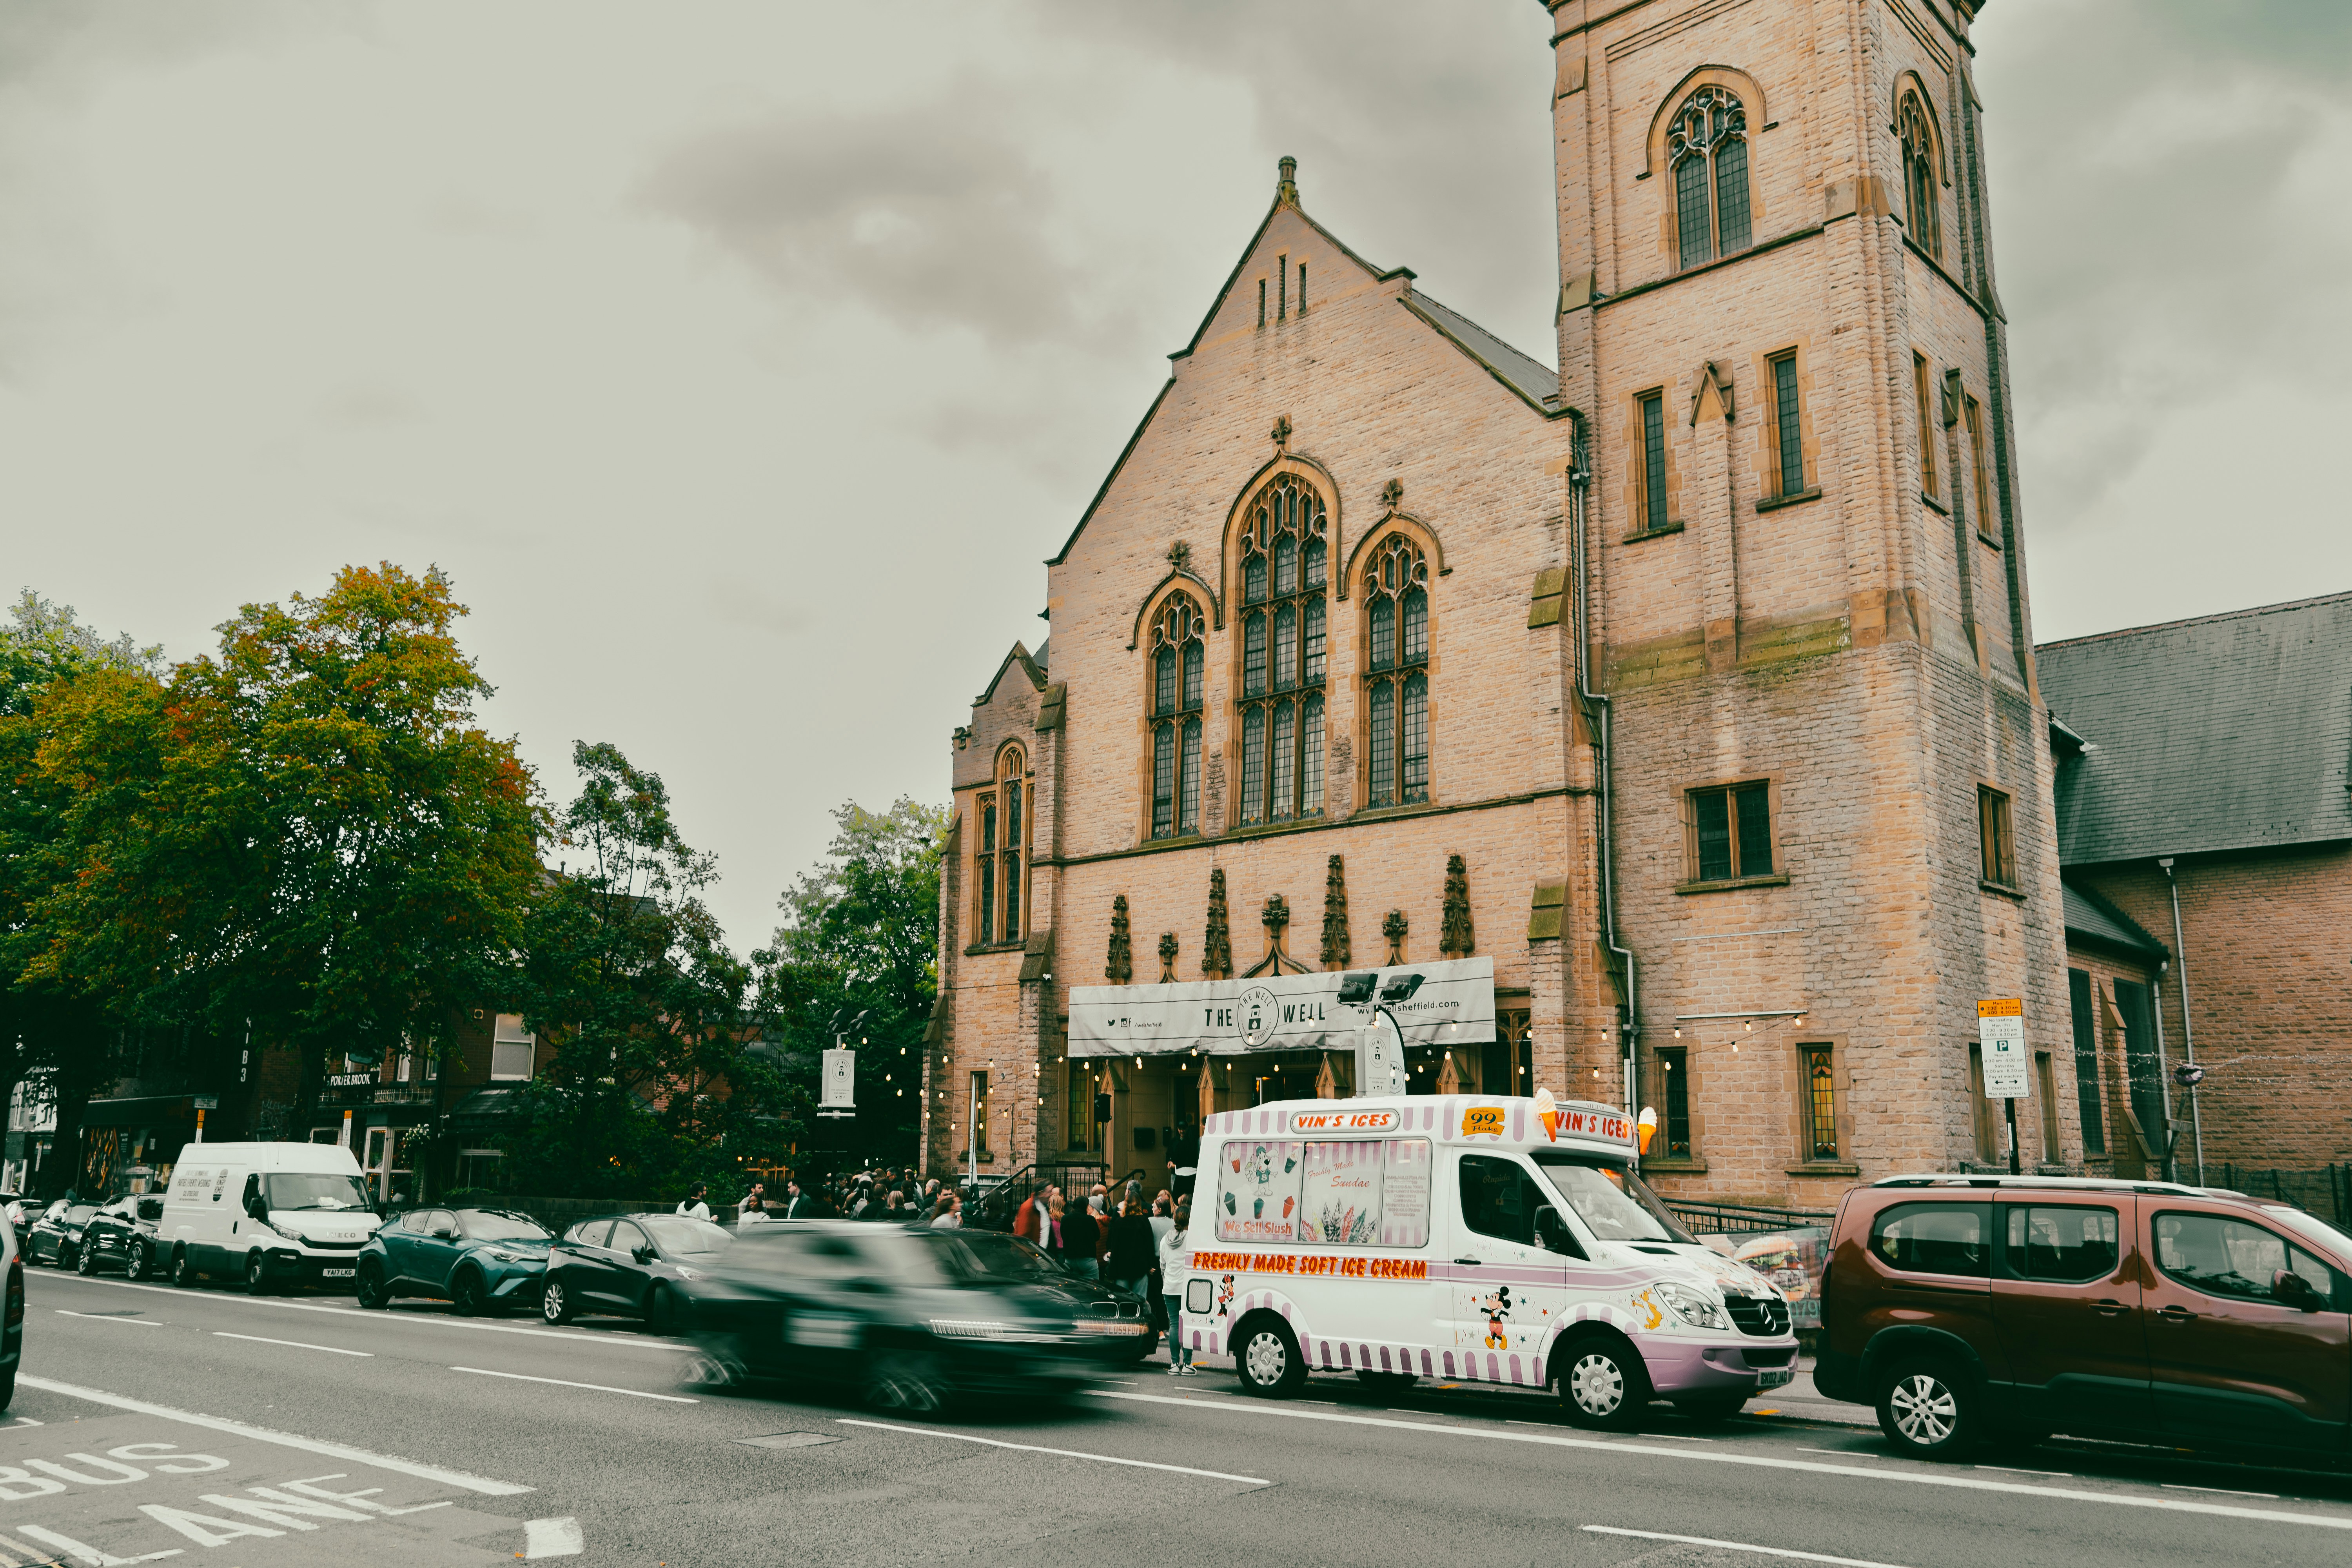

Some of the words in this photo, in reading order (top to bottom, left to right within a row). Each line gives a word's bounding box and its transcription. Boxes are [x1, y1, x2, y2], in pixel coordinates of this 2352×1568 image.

[1240, 993, 1252, 1008] THE
[1256, 991, 1272, 1007] WELL
[1205, 1009, 1232, 1027] THE
[1999, 1041, 2007, 1051] P
[351, 1074, 370, 1085] BROOK
[1298, 1115, 1345, 1128] VIN'S
[1349, 1113, 1391, 1127] ICES
[1471, 1113, 1496, 1124] 99
[1555, 1111, 1597, 1133] VIN'S
[1602, 1117, 1628, 1139] ICES
[1307, 1167, 1331, 1180] Freshly
[1334, 1160, 1354, 1171] Made
[1330, 1175, 1370, 1187] Sundae
[1224, 1220, 1241, 1233] We
[1243, 1221, 1262, 1234] Sell
[1265, 1221, 1291, 1234] Slush
[1192, 1252, 1252, 1271] FRESHLY
[1252, 1254, 1296, 1274] MADE
[1298, 1256, 1338, 1275] SOFT
[1340, 1257, 1368, 1277] ICE
[1370, 1259, 1427, 1279] CREAM
[1789, 1301, 1820, 1319] 079
[16, 1473, 453, 1567] LANE
